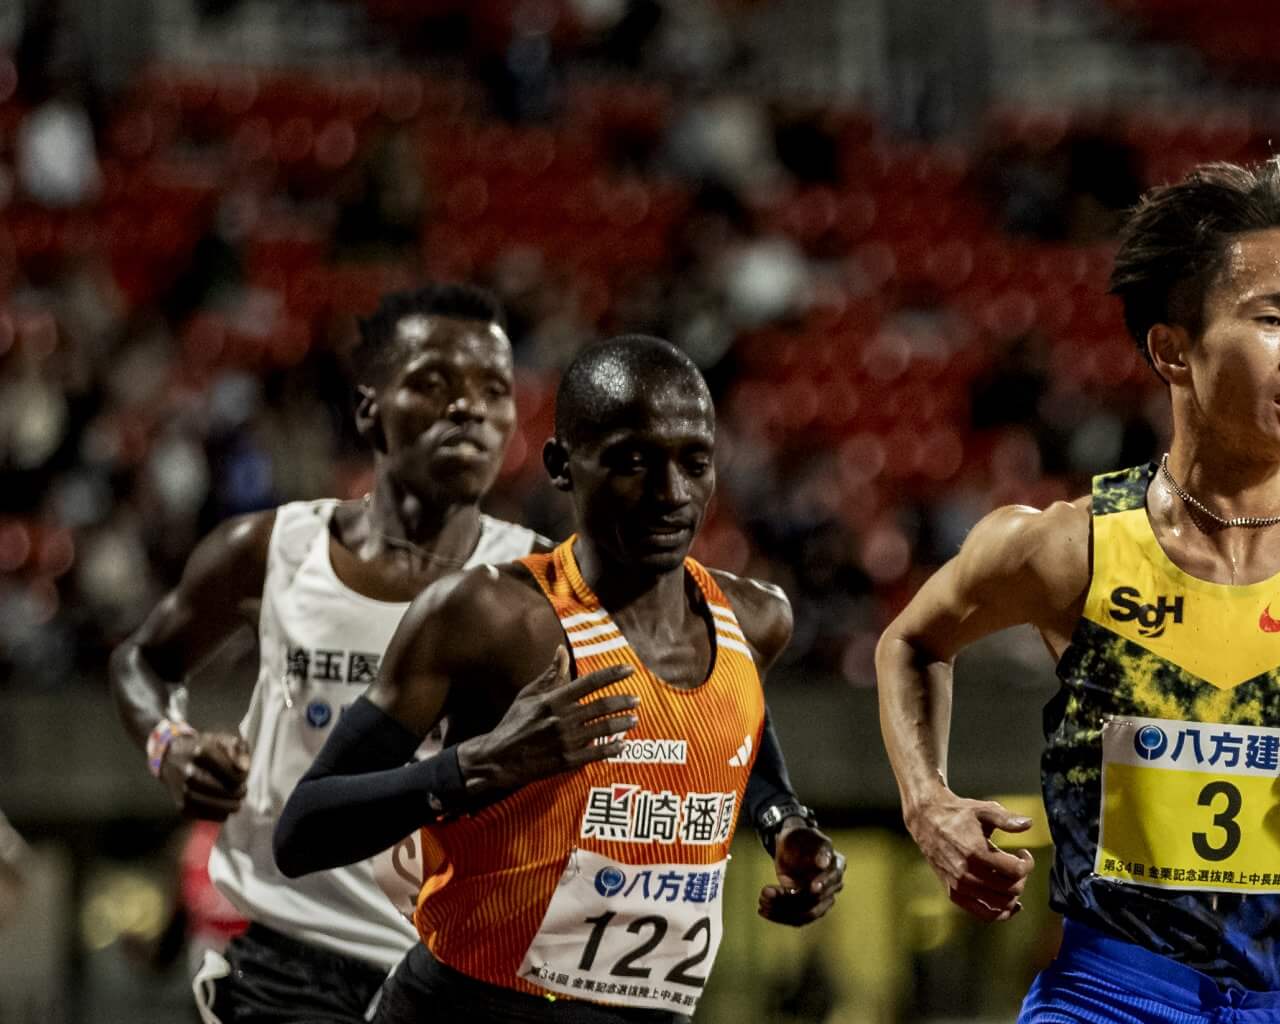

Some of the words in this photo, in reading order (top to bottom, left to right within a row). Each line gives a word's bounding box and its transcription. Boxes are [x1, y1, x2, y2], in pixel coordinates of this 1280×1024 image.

[617, 742, 685, 761] ROSAKI
[1191, 780, 1243, 862] 3
[578, 910, 712, 988] 122
